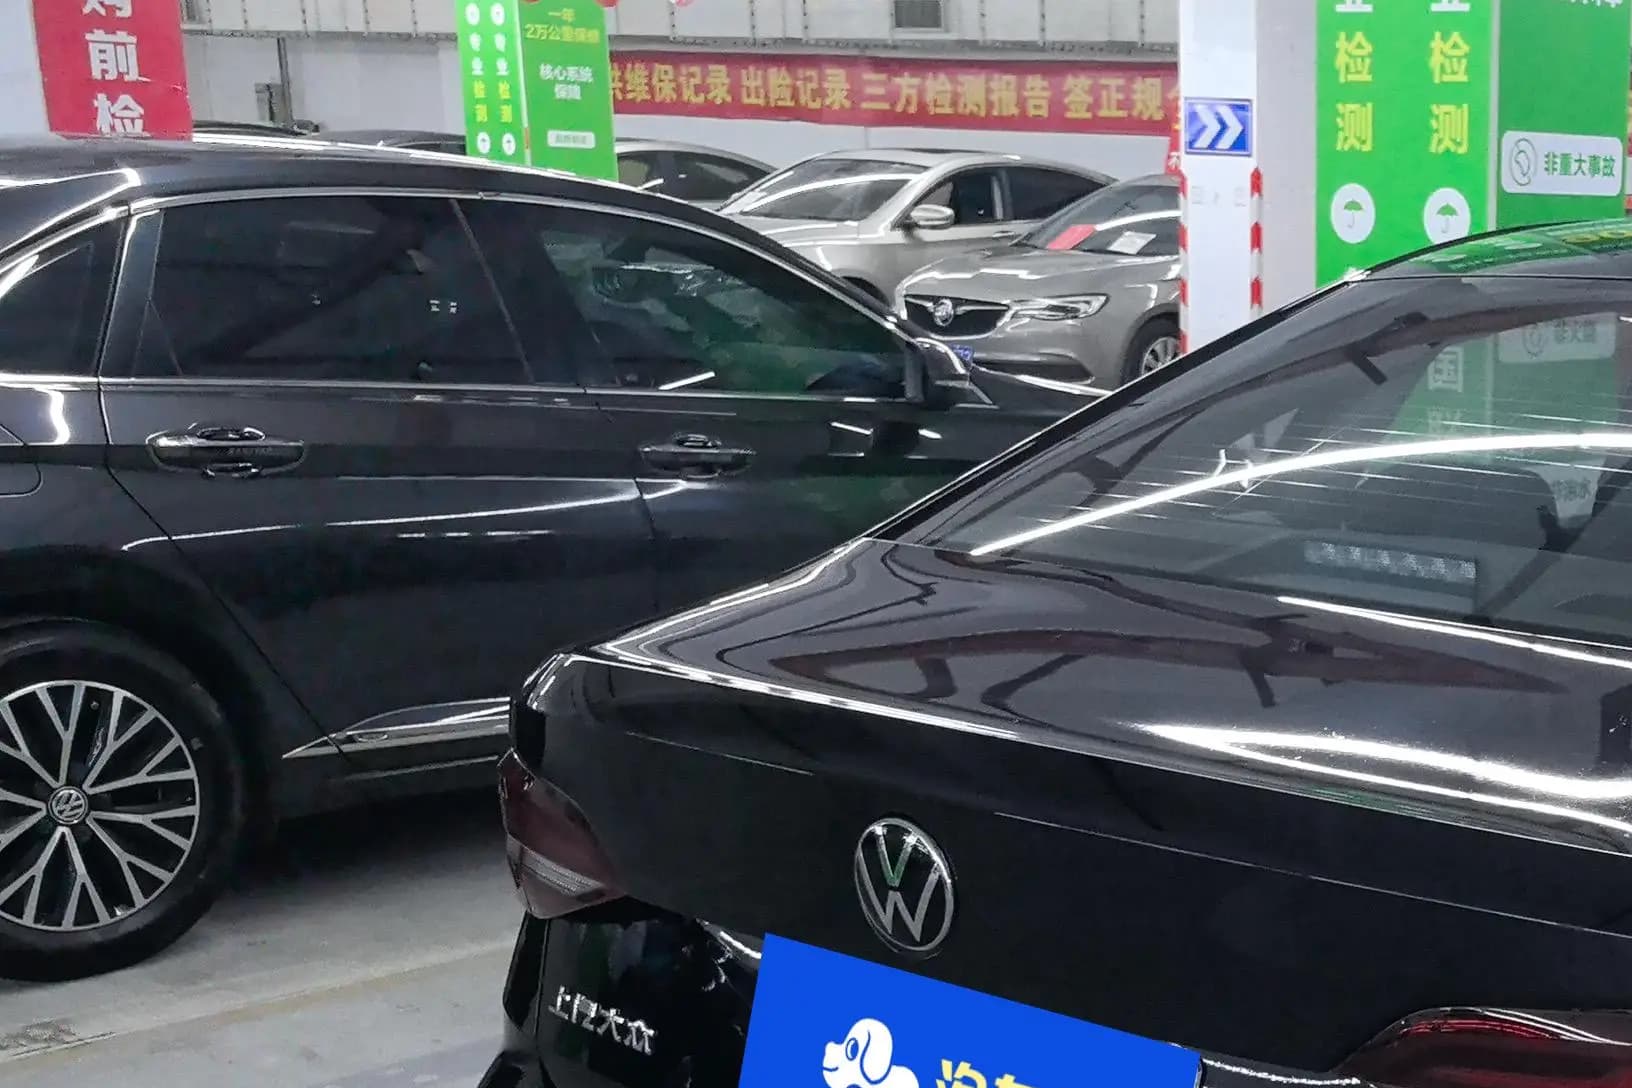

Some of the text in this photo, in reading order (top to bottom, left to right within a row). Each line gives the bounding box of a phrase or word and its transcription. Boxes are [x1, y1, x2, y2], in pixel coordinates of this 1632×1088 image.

[740, 65, 850, 110] 出险记录
[861, 70, 1052, 118] 三方检测报告
[1543, 151, 1616, 179] 非重大事故
